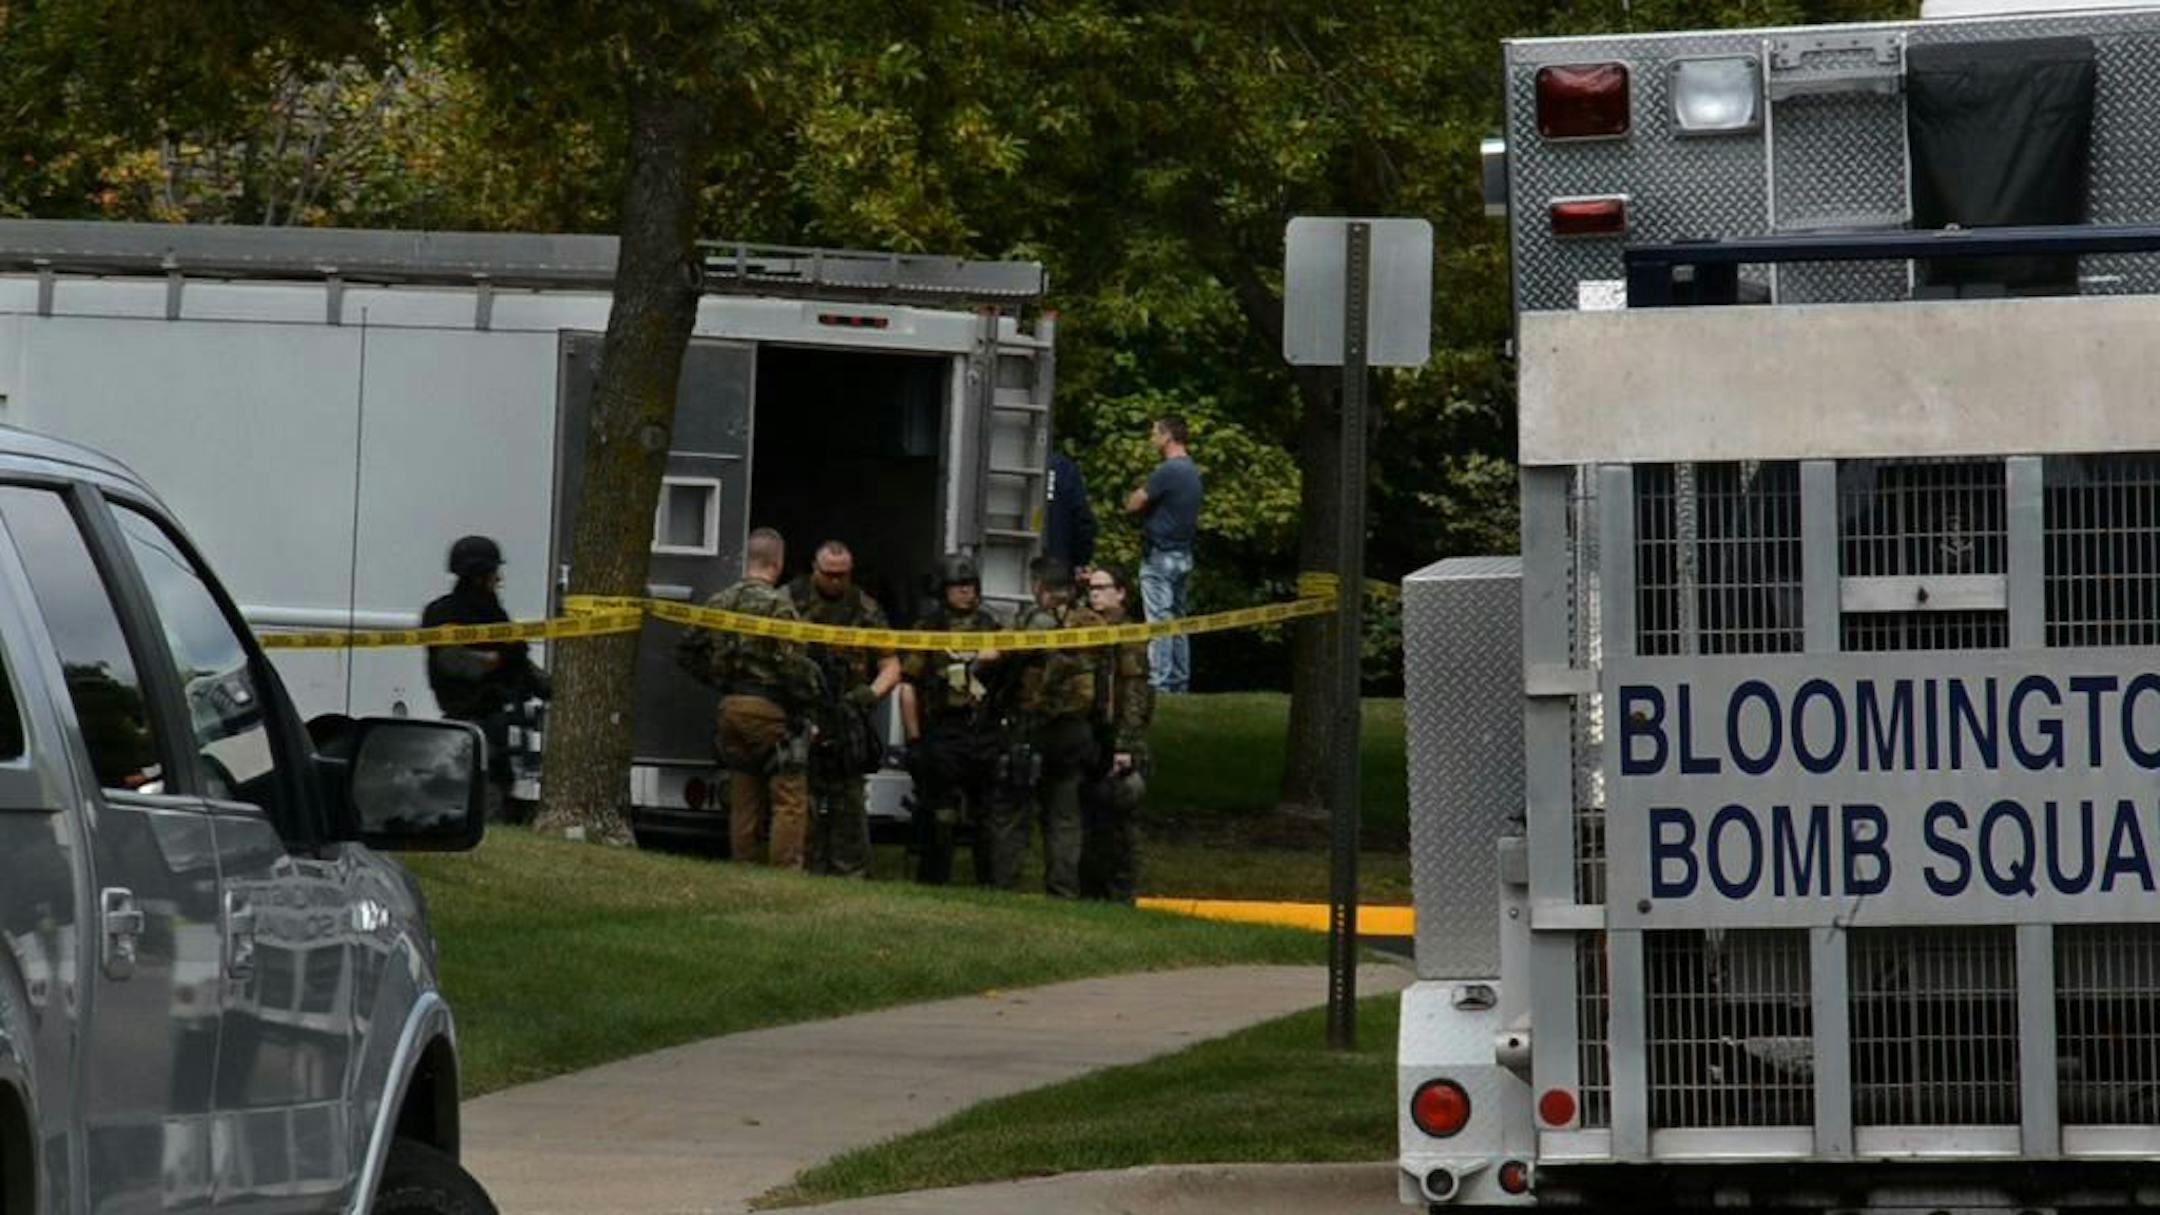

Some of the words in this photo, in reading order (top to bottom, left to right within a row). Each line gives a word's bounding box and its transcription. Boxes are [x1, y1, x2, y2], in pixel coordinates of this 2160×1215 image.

[1619, 673, 2160, 776] BLOOMINGTO
[1649, 804, 1893, 899] BOMB
[1923, 800, 2160, 899] SQUA
